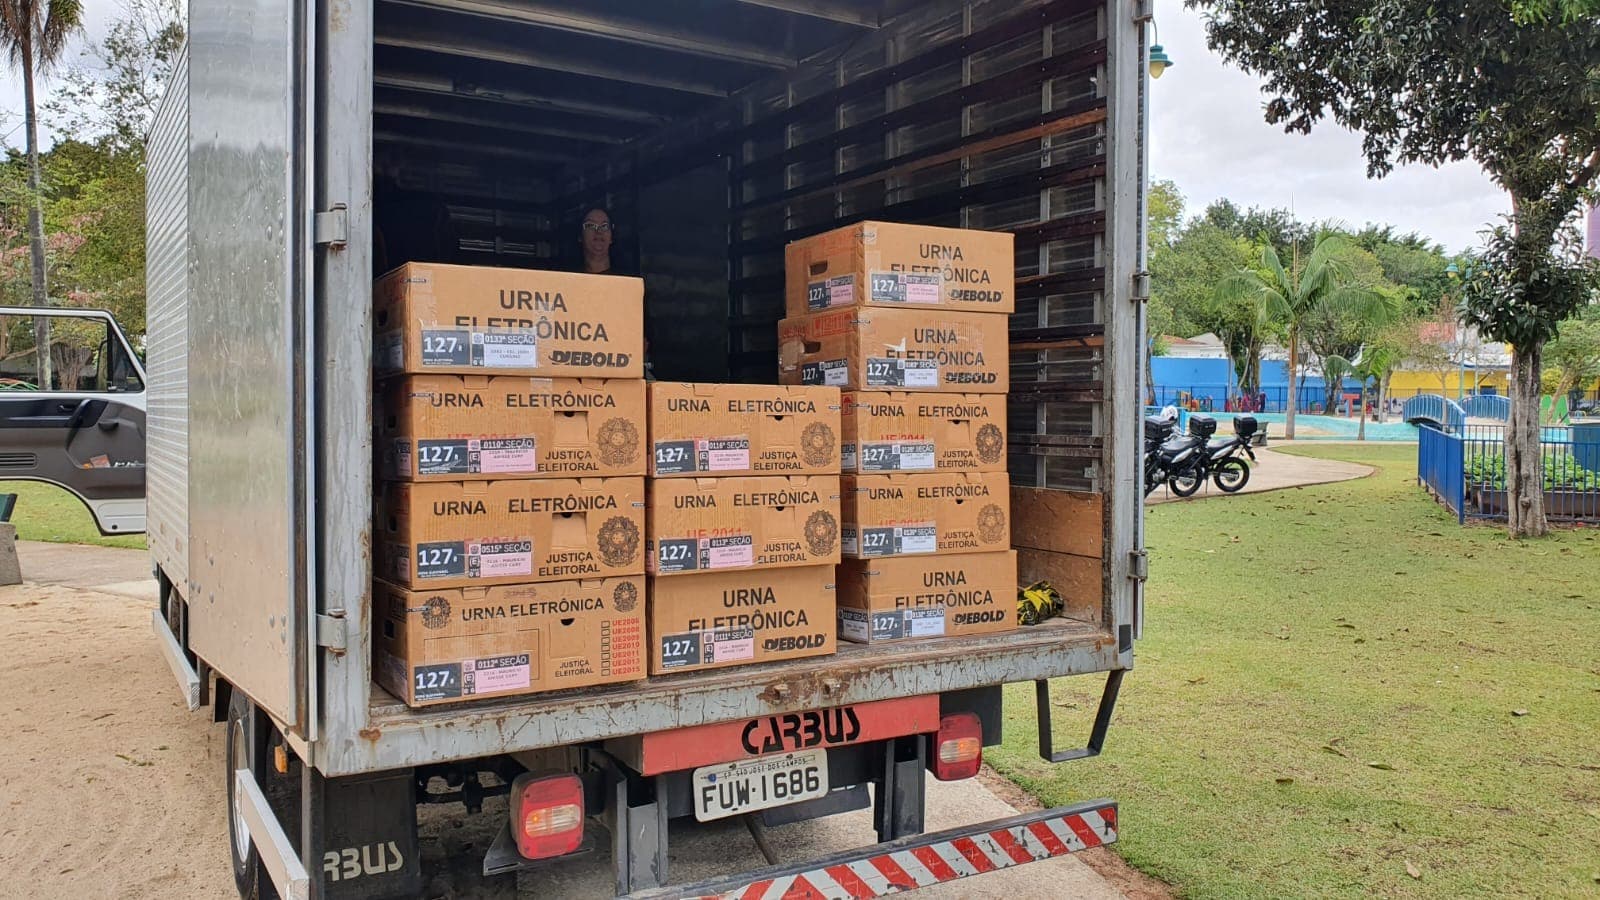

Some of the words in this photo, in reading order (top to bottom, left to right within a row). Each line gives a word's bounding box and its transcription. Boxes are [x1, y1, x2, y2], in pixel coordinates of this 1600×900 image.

[920, 244, 963, 261] URNA
[500, 290, 568, 312] URNA
[508, 334, 535, 344] SEÇÃO
[914, 328, 958, 344] URNA
[431, 392, 484, 408] URNA
[506, 391, 616, 408] ELETRÔNICA
[668, 398, 711, 412] URNA
[728, 397, 816, 413] ELETRÔNICA
[871, 405, 904, 416] URNA
[919, 404, 988, 417] ELETRÔNICA
[506, 439, 533, 449] SEÇÃO
[727, 440, 749, 449] SEÇÃO
[545, 450, 592, 462] JUSTIÇA
[759, 451, 798, 461] JUSTIÇA
[942, 451, 973, 459] JUSTIÇA
[537, 462, 599, 472] ELEITORAL
[754, 462, 803, 470] ELEITORAL
[869, 488, 903, 499] URNA
[918, 484, 989, 498] ELETRÔNICA
[674, 495, 716, 508] URNA
[734, 490, 819, 506] ELETRÔNICA
[433, 500, 487, 516] URNA
[508, 494, 617, 513] ELETRÔNICA
[943, 531, 974, 539] JUSTIÇA
[729, 537, 750, 546] SEÇÃO
[764, 542, 801, 552] JUSTIÇA
[939, 541, 978, 549] ELEITORAL
[504, 543, 531, 553] SEÇÃO
[546, 553, 593, 564] JUSTIÇA
[758, 553, 806, 564] ELEITORAL
[538, 565, 600, 577] ELEITORAL
[923, 570, 966, 587] URNA
[723, 587, 776, 607] URNA
[462, 606, 506, 622] URNA
[510, 598, 604, 617] ELETRÔNICA
[732, 630, 752, 639] SEÇÃO
[500, 656, 527, 666] SEÇÃO
[560, 659, 589, 669] JUSTIÇA
[555, 667, 594, 677] ELEITORAL
[741, 708, 860, 754] CARBUS
[768, 763, 780, 771] DOS
[782, 758, 806, 767] CAMPOS
